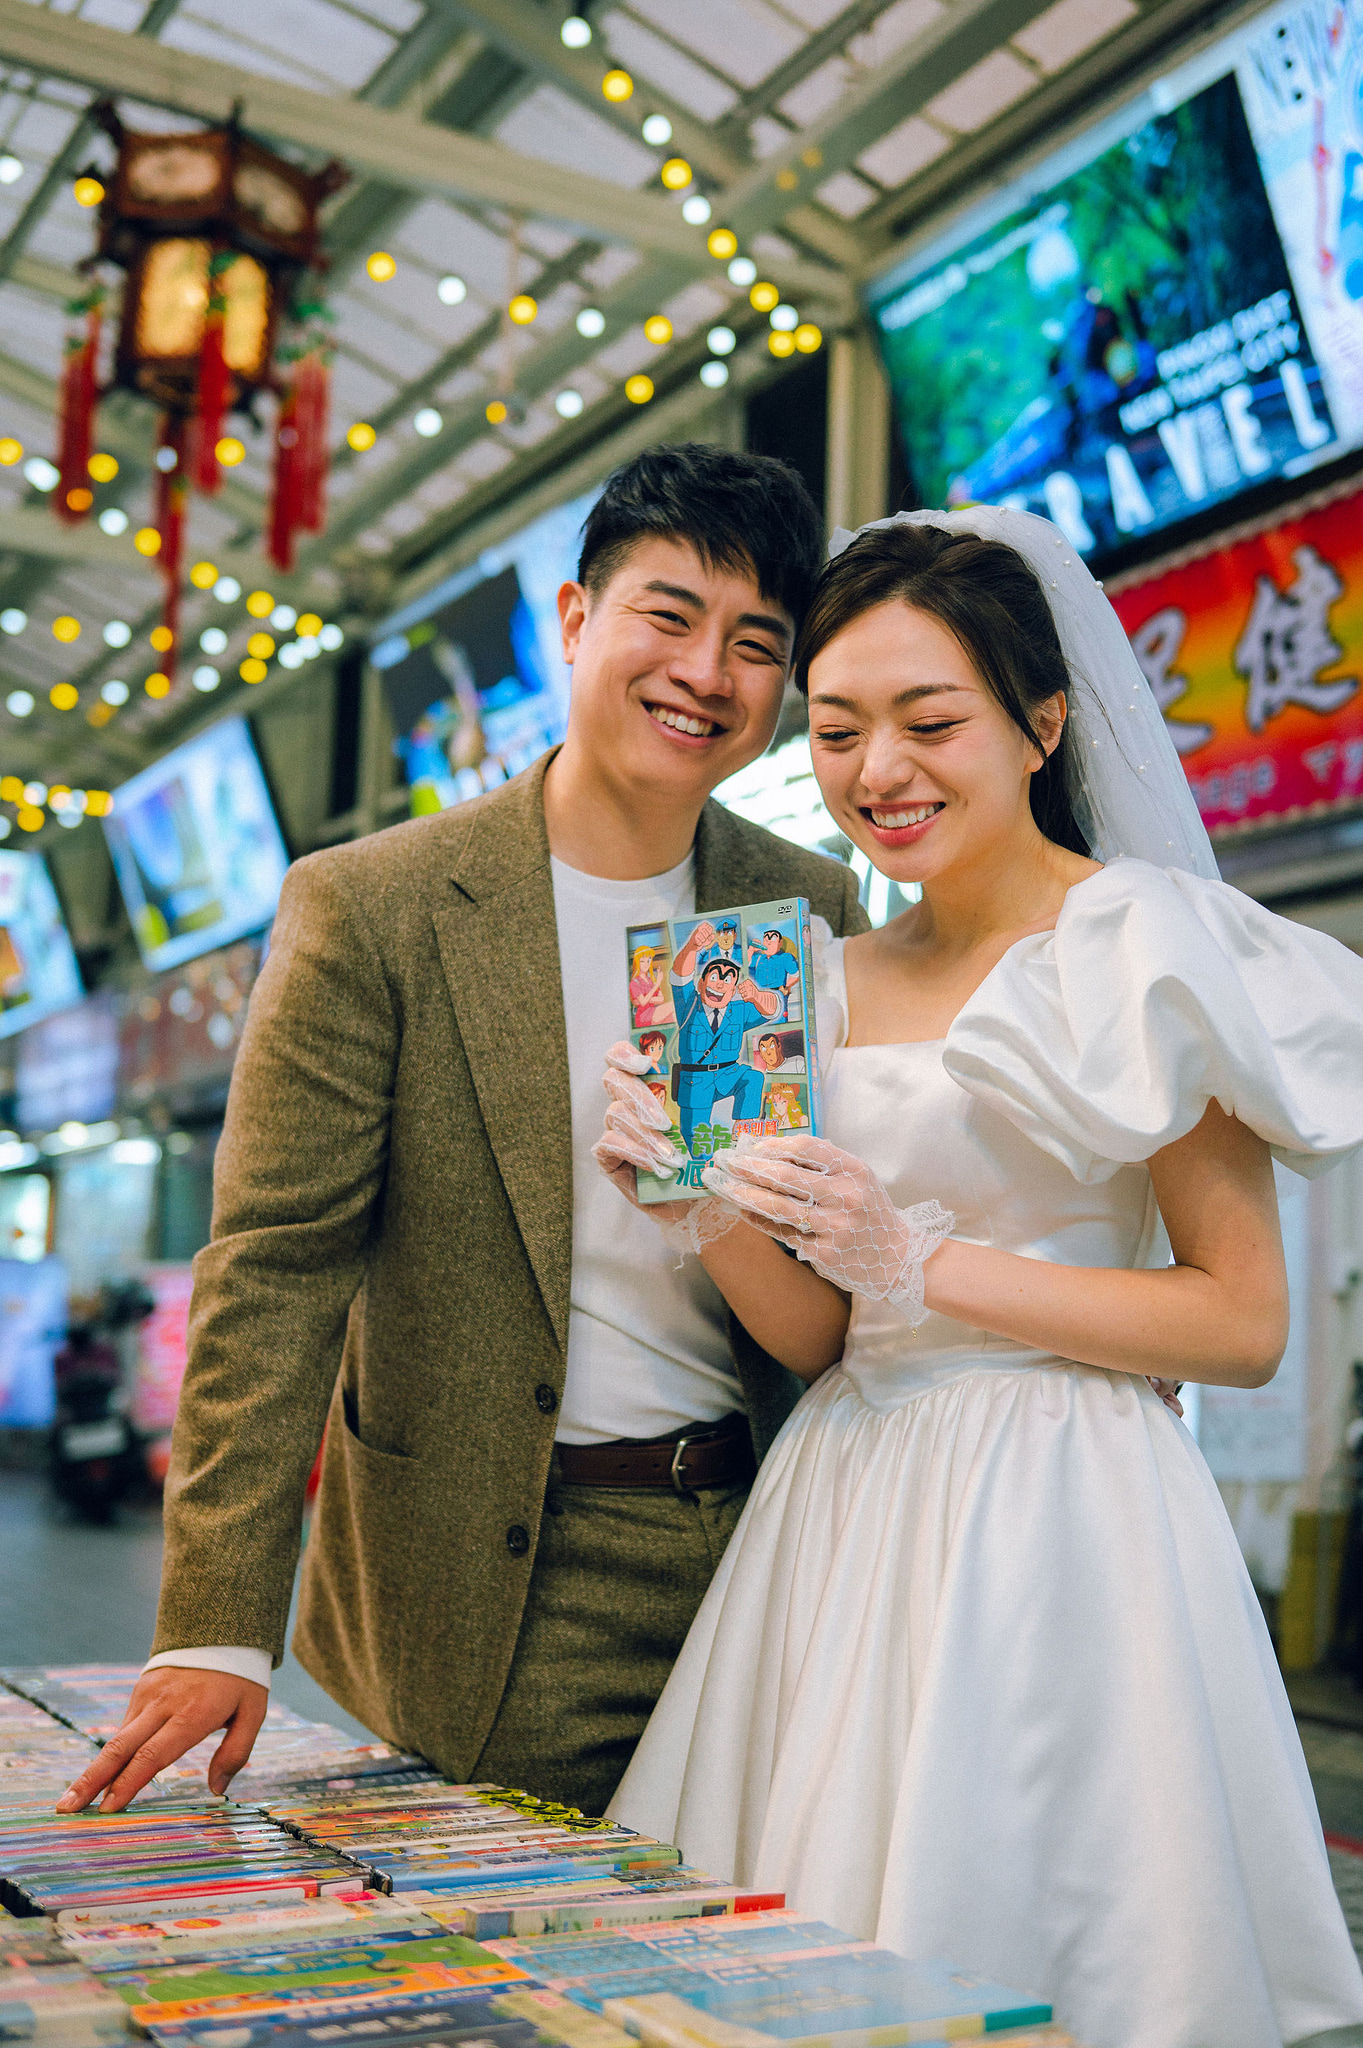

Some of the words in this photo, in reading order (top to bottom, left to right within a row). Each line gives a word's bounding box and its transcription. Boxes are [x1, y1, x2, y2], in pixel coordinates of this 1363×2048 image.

[1010, 359, 1330, 551] RAVEL
[735, 1119, 778, 1138] 特別篇
